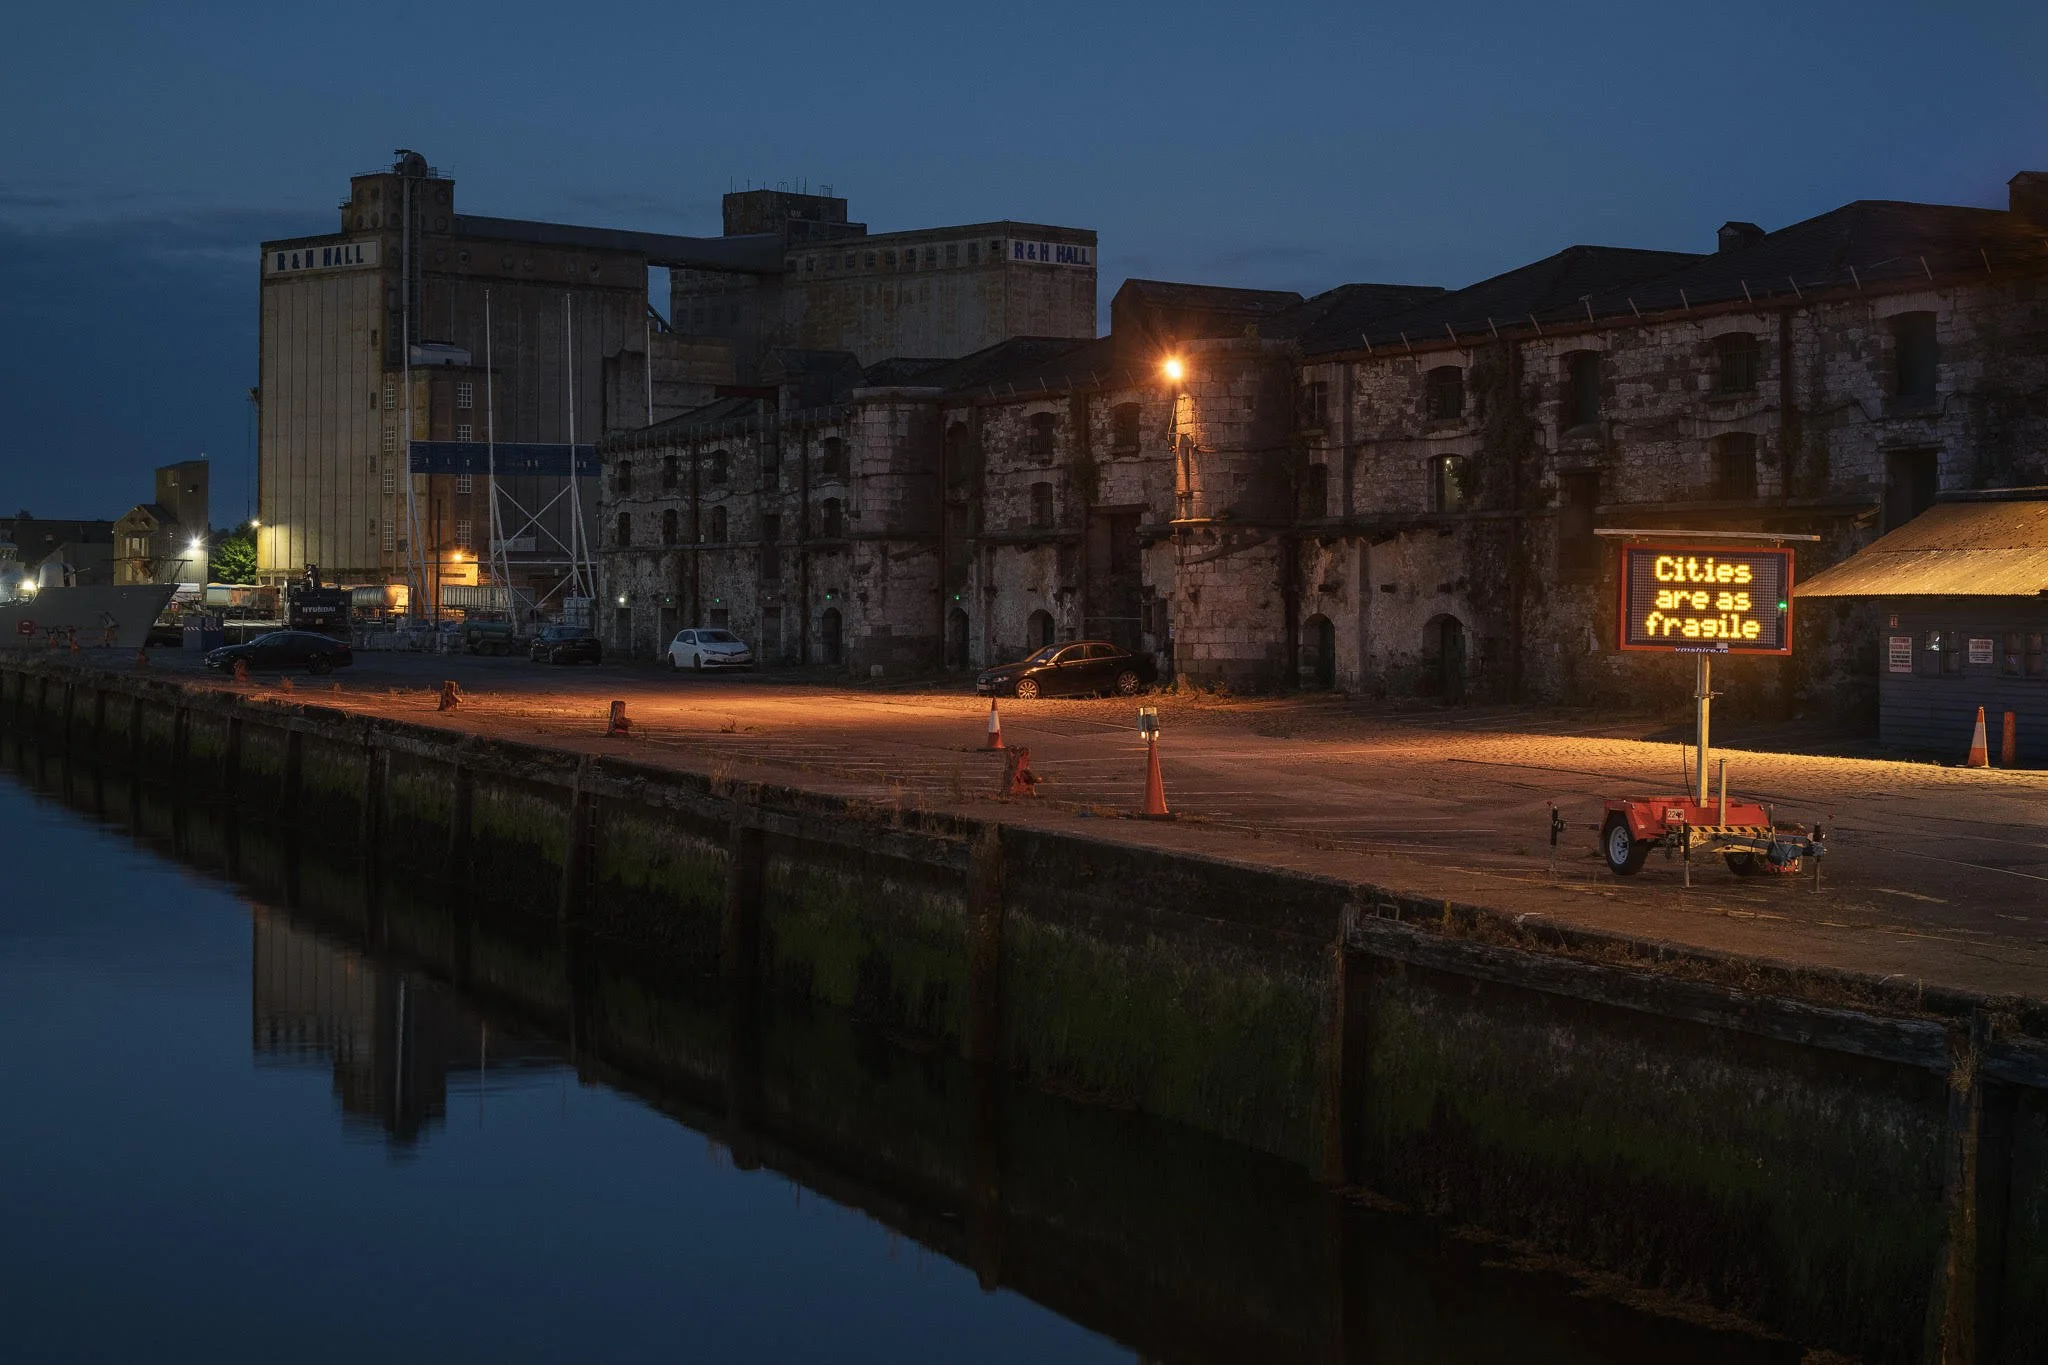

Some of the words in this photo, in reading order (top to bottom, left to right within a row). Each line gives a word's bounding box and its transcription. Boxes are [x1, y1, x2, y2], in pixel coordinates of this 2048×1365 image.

[278, 252, 286, 271] R
[292, 253, 300, 269] &
[306, 249, 314, 268] H
[324, 245, 364, 266] HALL
[1015, 241, 1024, 259] R
[1027, 243, 1036, 260] &
[1040, 243, 1049, 261] H
[1056, 245, 1090, 265] HALL
[1655, 555, 1753, 584] Cities
[1655, 589, 1710, 610] are
[1715, 591, 1752, 611] as
[1645, 611, 1761, 640] fragile
